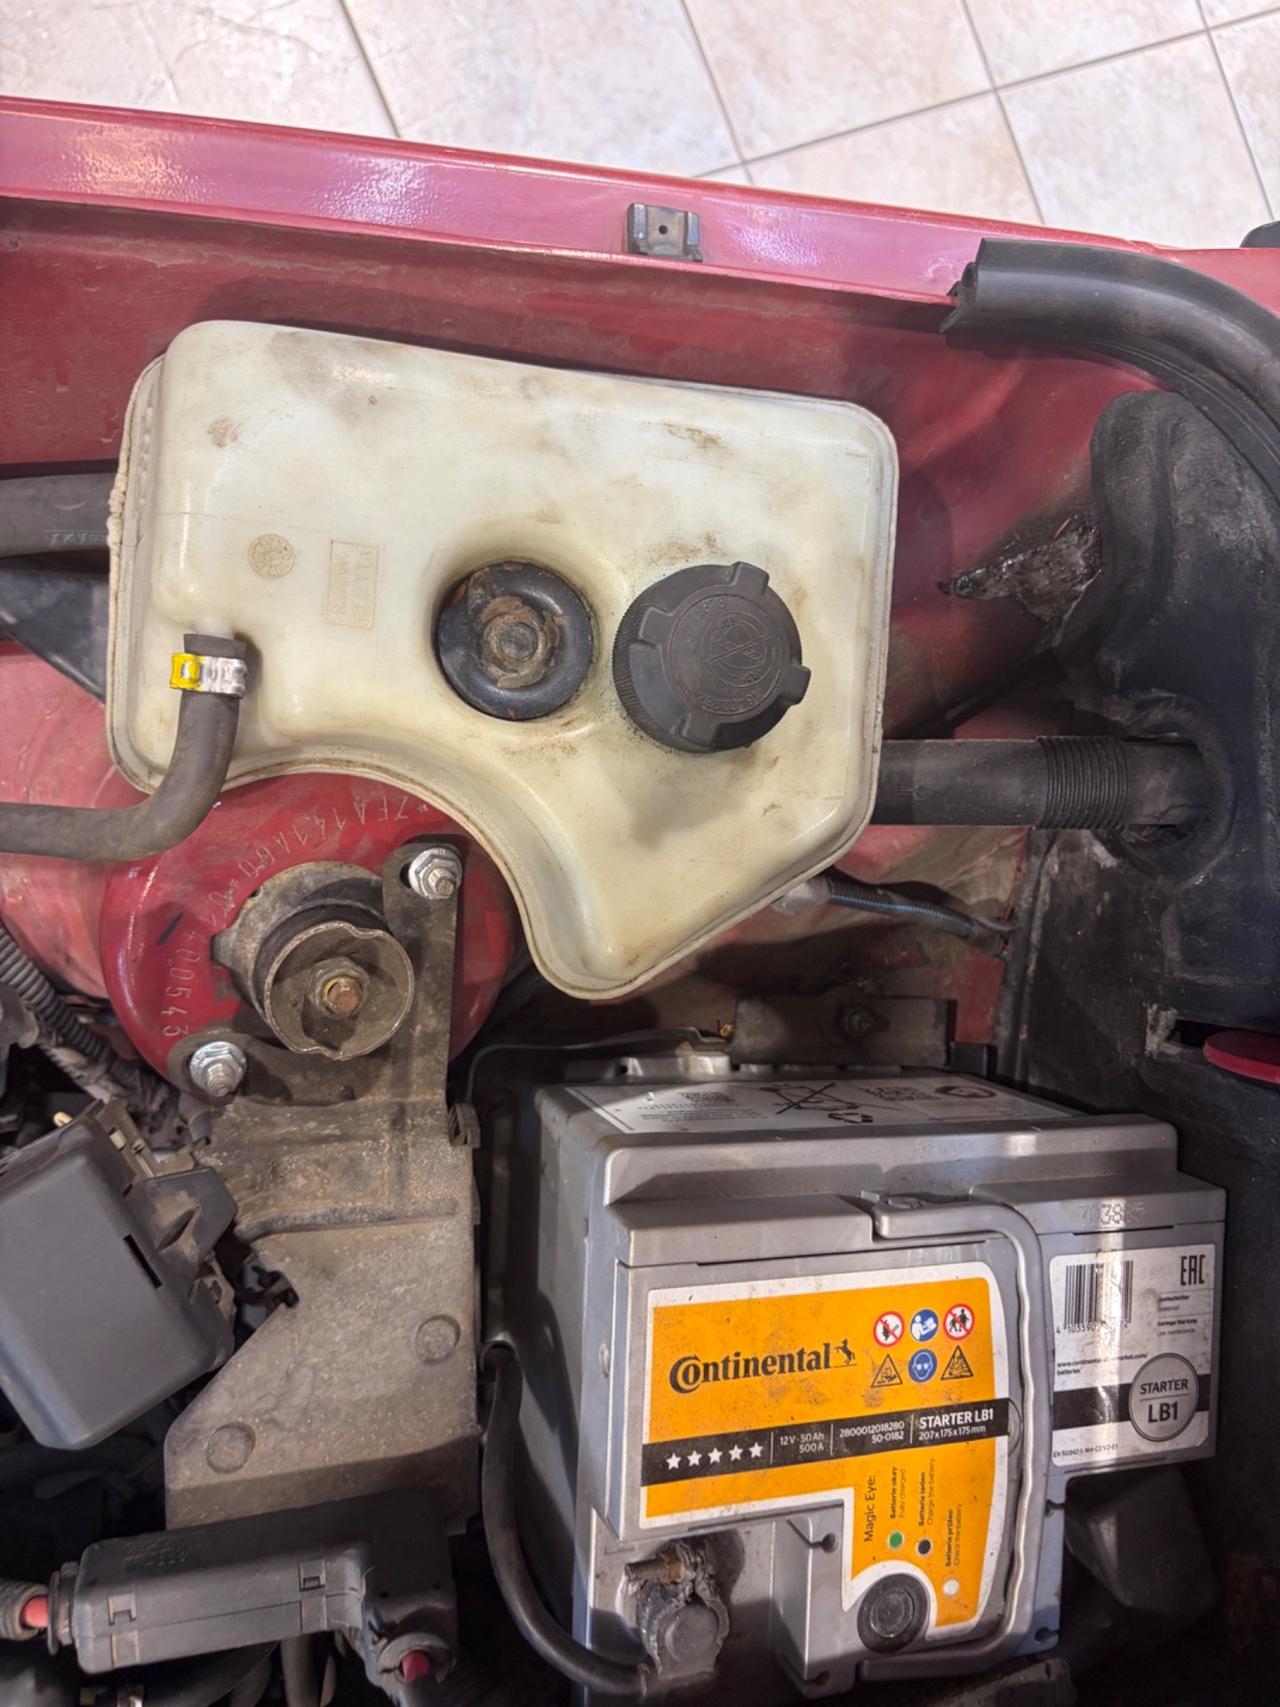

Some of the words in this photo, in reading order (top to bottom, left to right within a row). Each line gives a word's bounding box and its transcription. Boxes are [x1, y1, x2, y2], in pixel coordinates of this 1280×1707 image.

[1181, 1254, 1205, 1286] EAC
[669, 1343, 831, 1394] Continental
[1140, 1378, 1188, 1395] STARTER
[920, 1410, 973, 1429] STARTER
[975, 1408, 994, 1422] LB1
[1148, 1401, 1178, 1423] LB1
[864, 1504, 877, 1542] Magic
